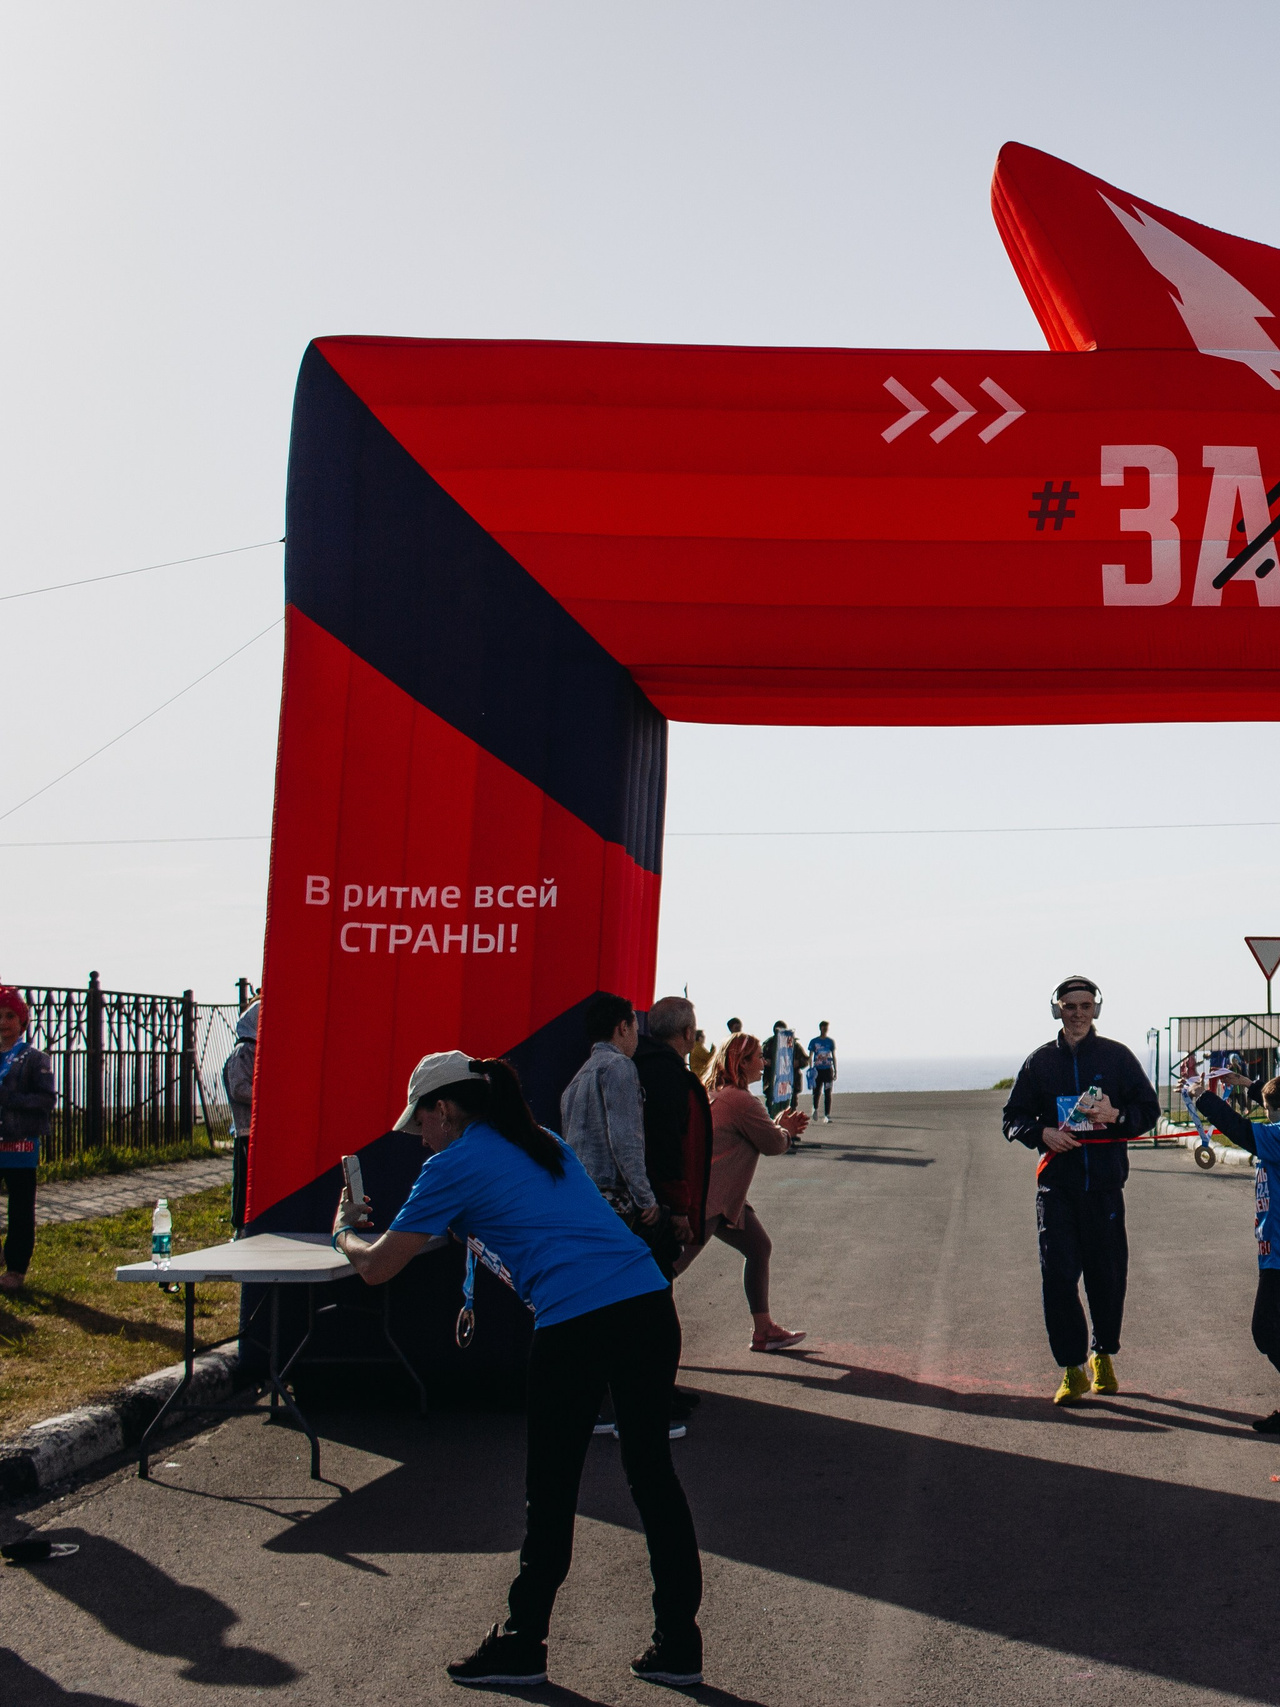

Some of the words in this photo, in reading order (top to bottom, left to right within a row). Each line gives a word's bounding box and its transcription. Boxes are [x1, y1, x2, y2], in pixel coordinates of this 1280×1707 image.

[305, 875, 331, 906] В
[343, 884, 461, 912] ритме
[474, 878, 558, 908] всей
[340, 922, 519, 954] СТРАНЫ!
